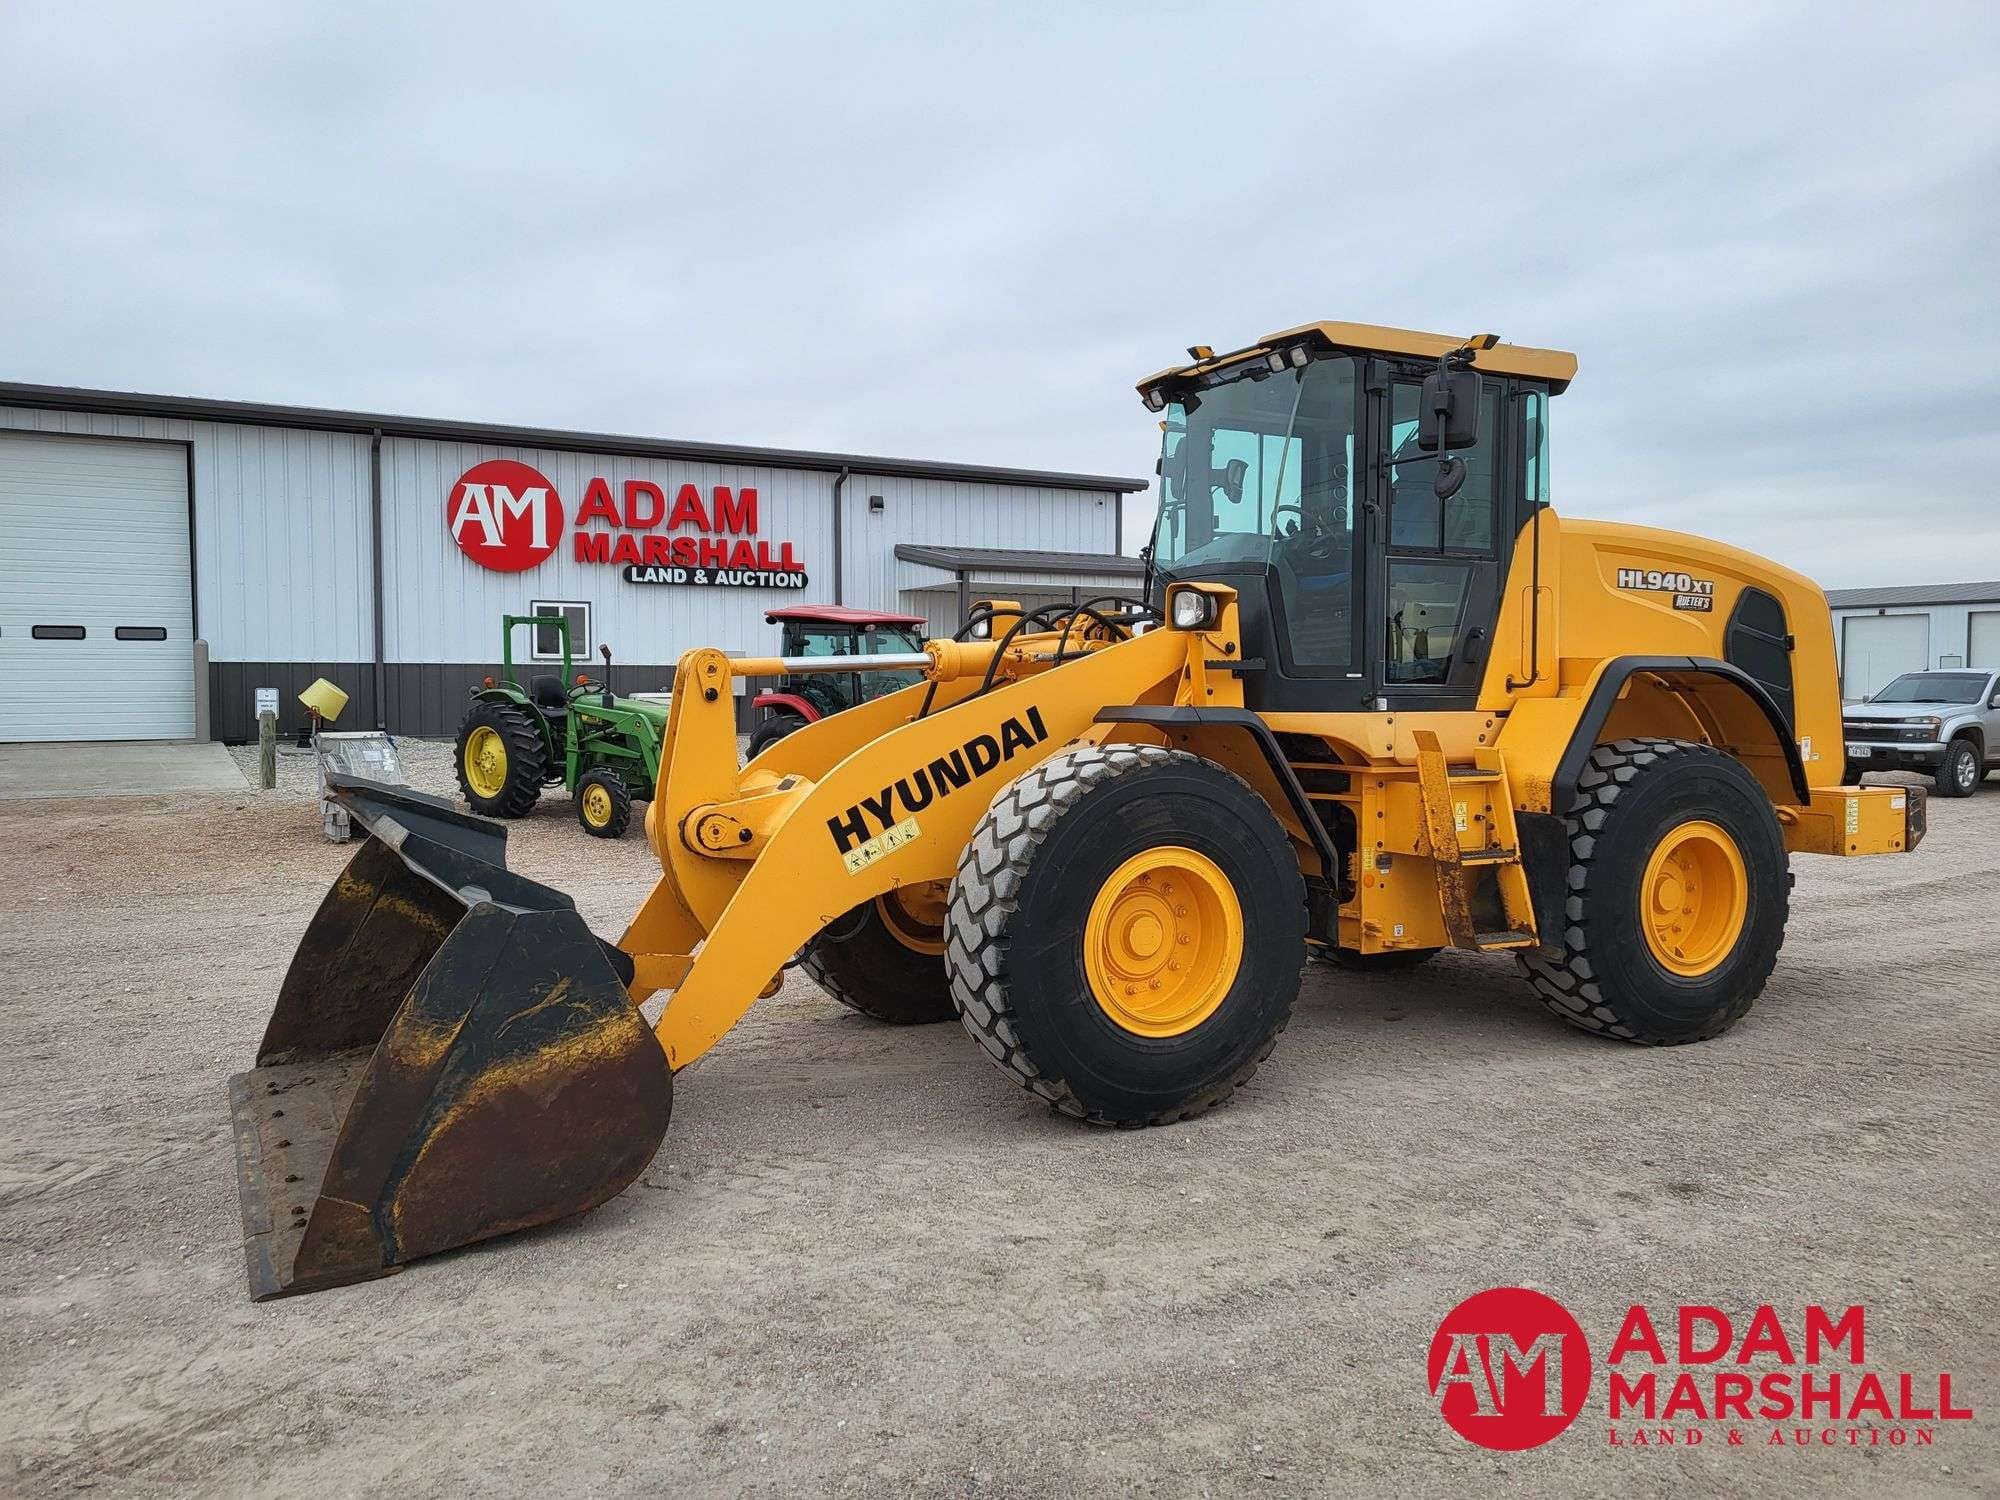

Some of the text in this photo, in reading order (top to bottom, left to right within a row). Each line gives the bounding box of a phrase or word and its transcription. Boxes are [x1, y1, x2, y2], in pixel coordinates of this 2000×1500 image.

[452, 482, 550, 549] AM
[575, 477, 758, 534] ADAM
[574, 532, 805, 571] MARSHALL
[631, 566, 804, 588] LAND & AUCTION
[827, 705, 1049, 855] HYUNDAI
